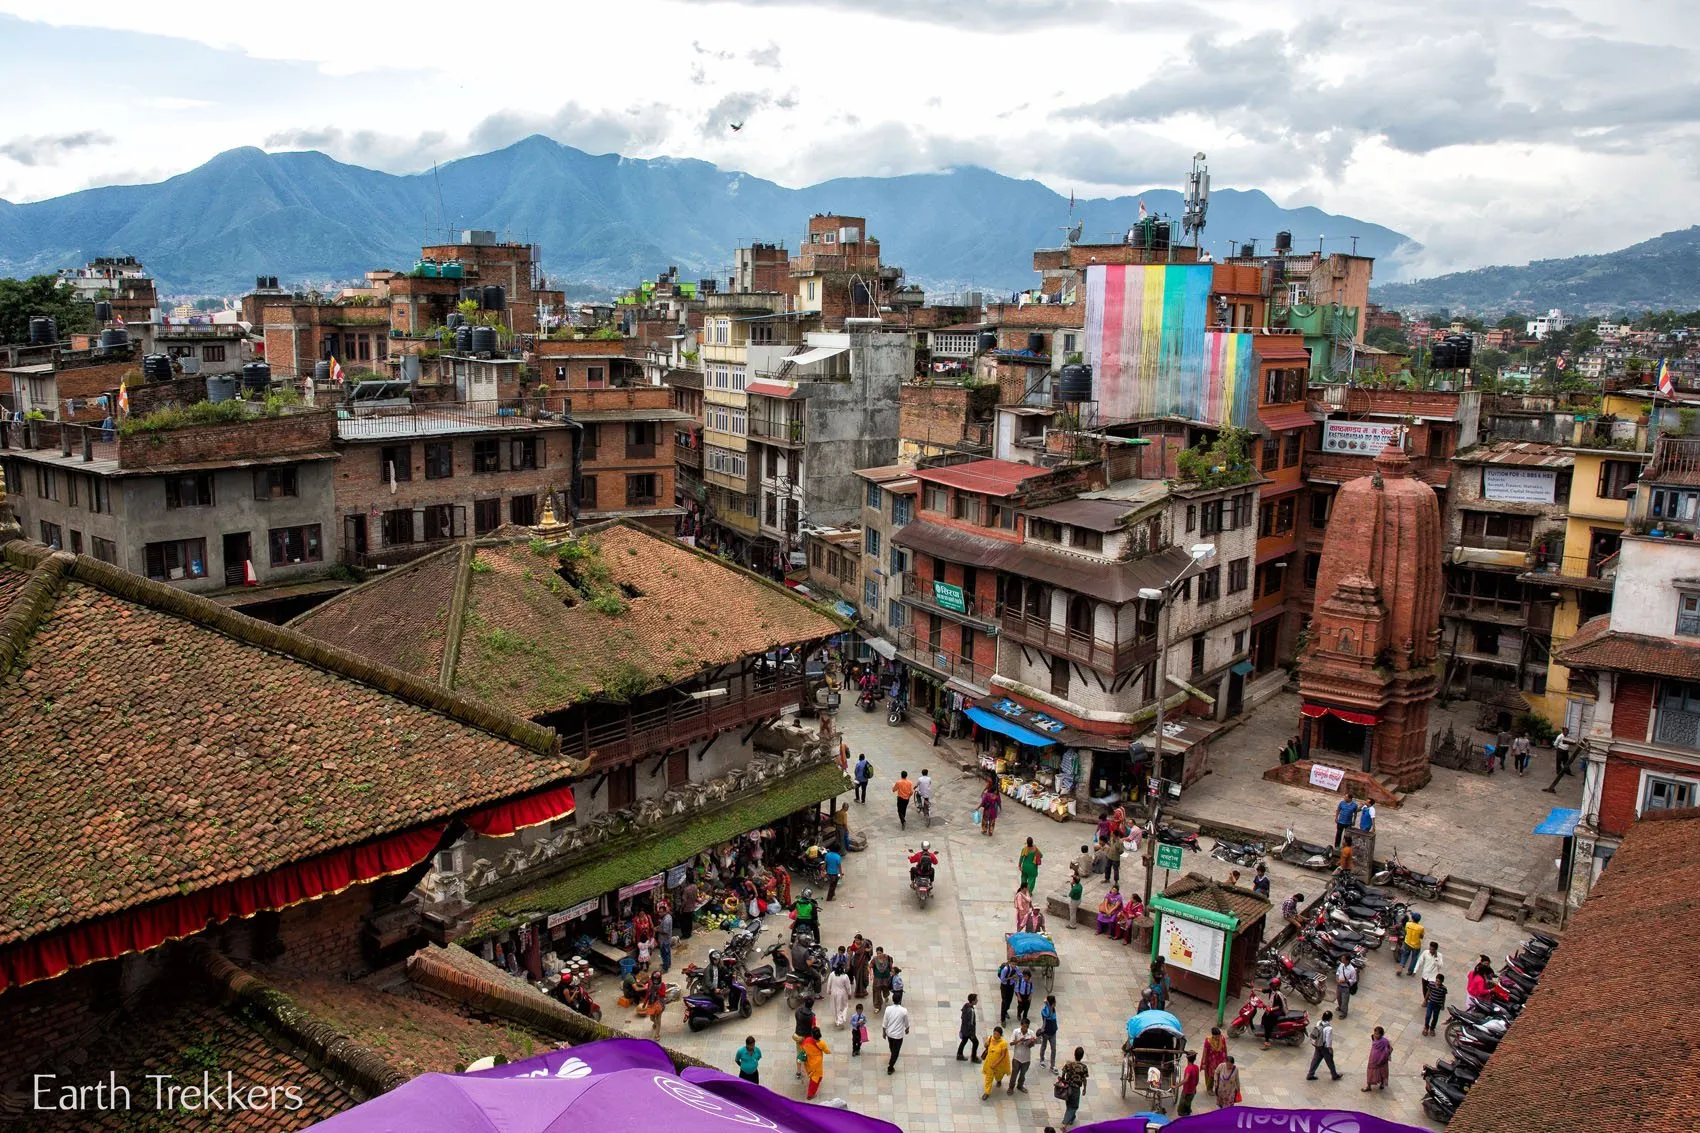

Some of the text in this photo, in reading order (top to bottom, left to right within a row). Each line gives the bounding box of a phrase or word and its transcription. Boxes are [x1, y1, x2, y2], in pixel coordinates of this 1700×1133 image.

[1154, 904, 1176, 914] WELCOME
[1183, 912, 1199, 920] WORLD
[1200, 916, 1220, 926] HERITAGE
